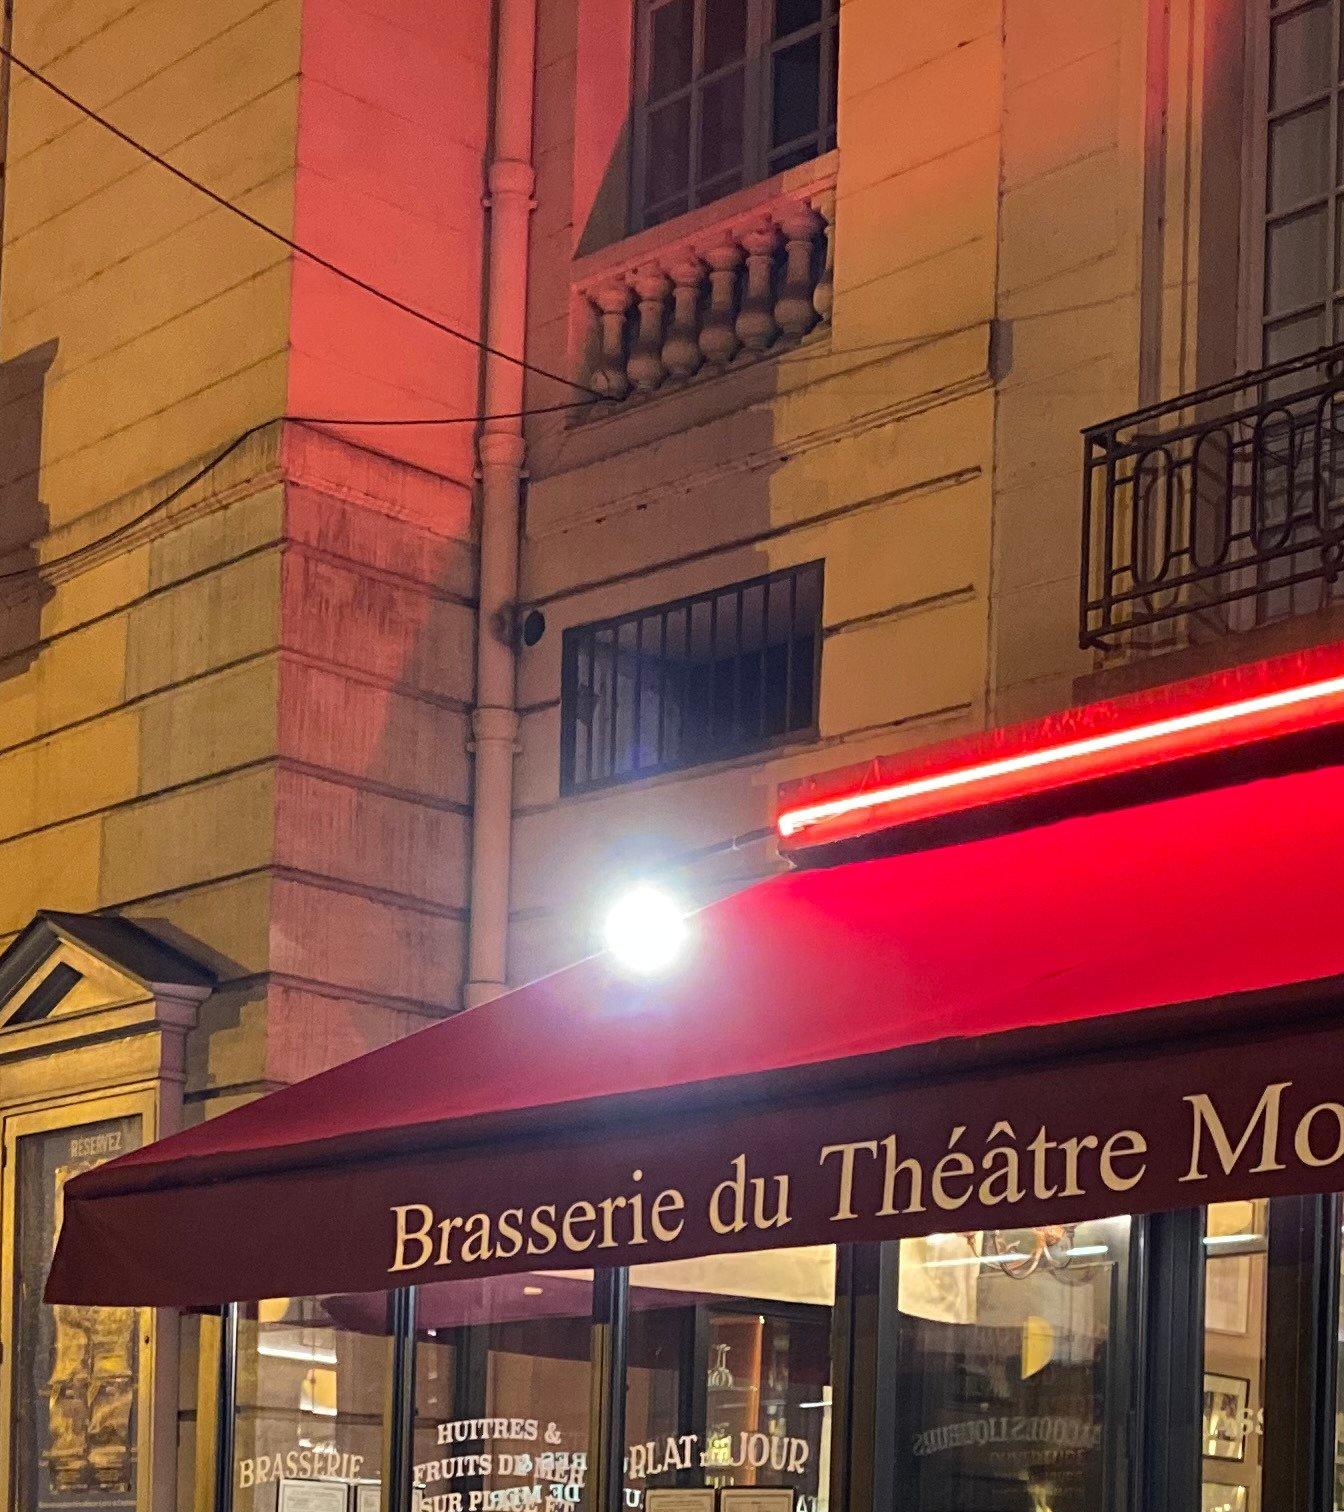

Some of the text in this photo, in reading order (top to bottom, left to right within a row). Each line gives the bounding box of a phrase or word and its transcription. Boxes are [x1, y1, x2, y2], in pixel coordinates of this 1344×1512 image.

[387, 1169, 685, 1273] Brasserie
[709, 1153, 792, 1235] du
[819, 1120, 1147, 1221] Théâtre
[437, 1418, 562, 1445] HUITRES &
[239, 1451, 364, 1489] BRASSERIE
[413, 1454, 492, 1484] FRUITS
[629, 1434, 699, 1480] PLAT
[730, 1431, 809, 1475] JOUR
